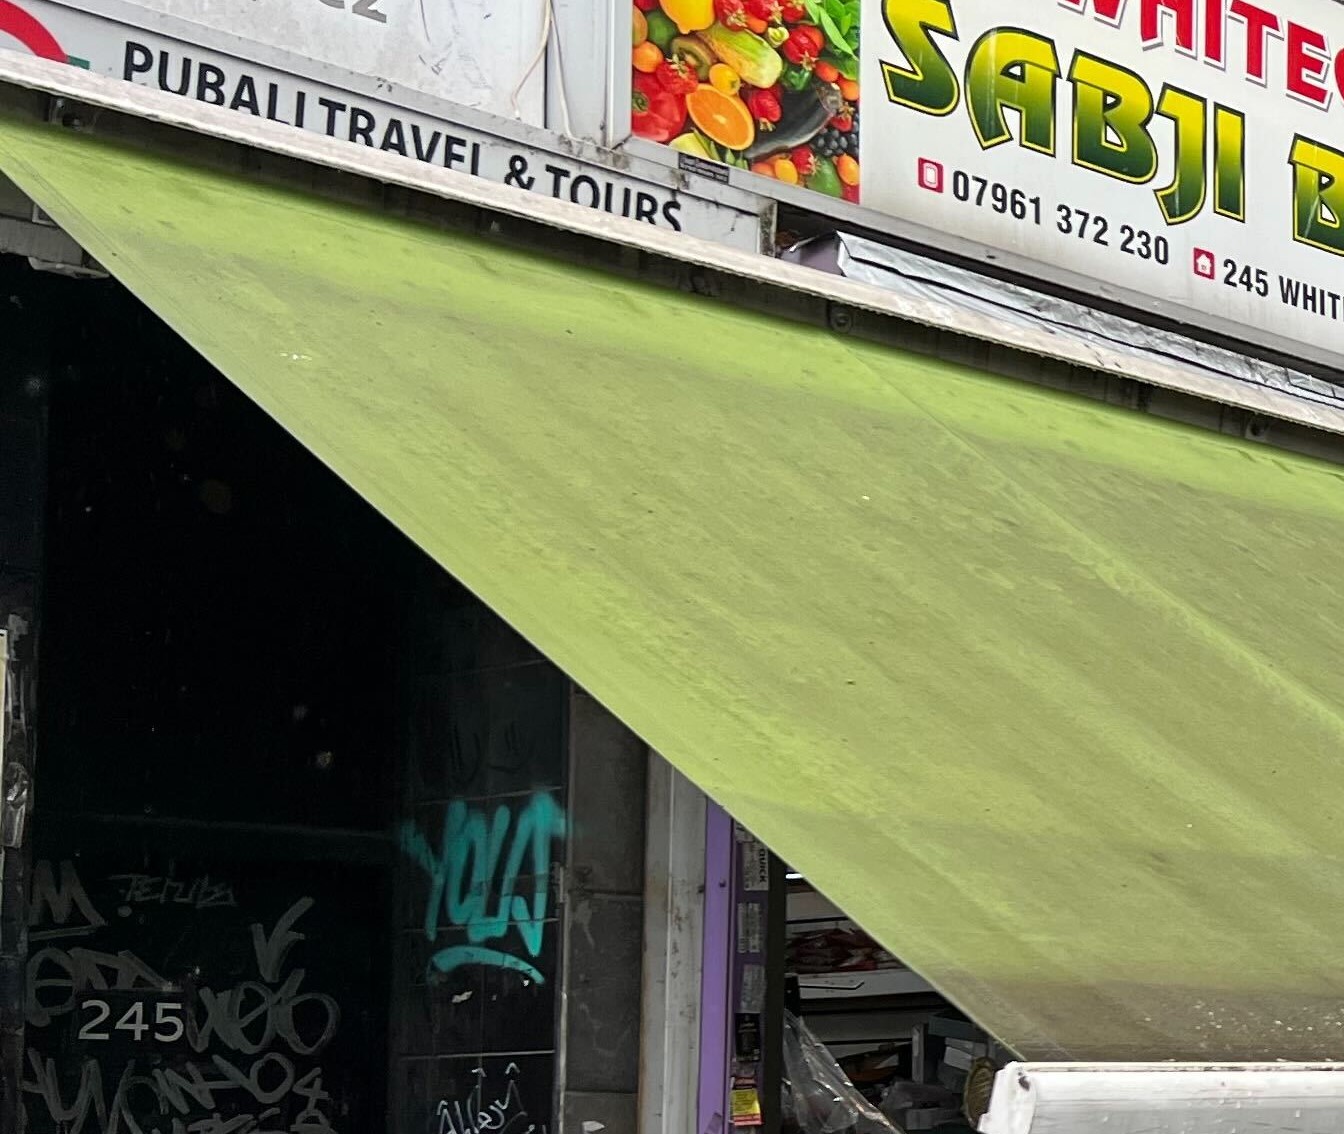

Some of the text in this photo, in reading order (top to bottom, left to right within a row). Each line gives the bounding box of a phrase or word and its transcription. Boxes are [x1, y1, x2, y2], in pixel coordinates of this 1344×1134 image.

[123, 41, 306, 128] PUBALI
[504, 155, 535, 190] &
[879, 0, 1247, 224] SABJI
[953, 170, 1169, 265] 07961 372 230
[1223, 258, 1269, 298] 245
[78, 1000, 184, 1042] 245
